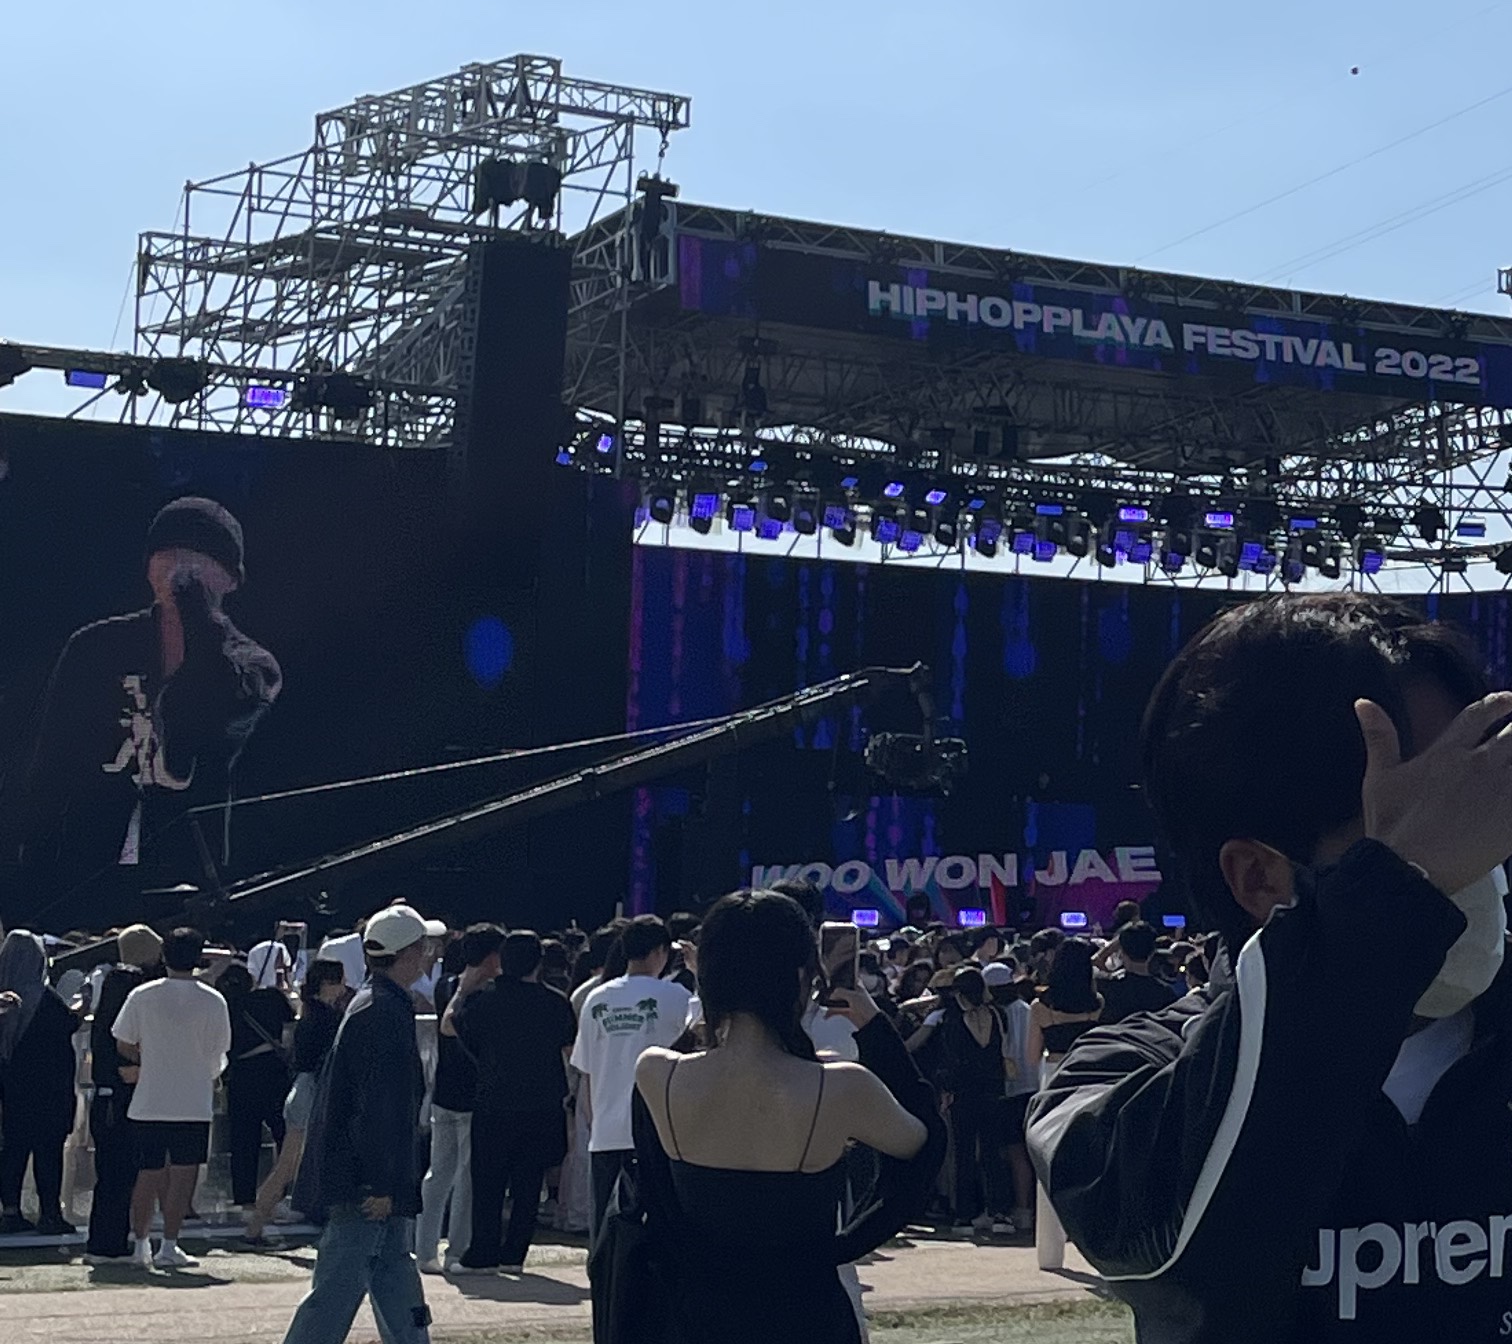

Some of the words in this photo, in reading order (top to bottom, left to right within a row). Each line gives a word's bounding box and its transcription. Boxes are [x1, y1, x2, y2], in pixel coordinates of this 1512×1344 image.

[868, 281, 1174, 348] HIPHOPPLAYA
[1182, 323, 1366, 372] FESTIVAL
[1375, 348, 1480, 384] 2022
[752, 860, 871, 893] WOO
[885, 853, 1018, 891] WON
[1035, 846, 1162, 886] JAE
